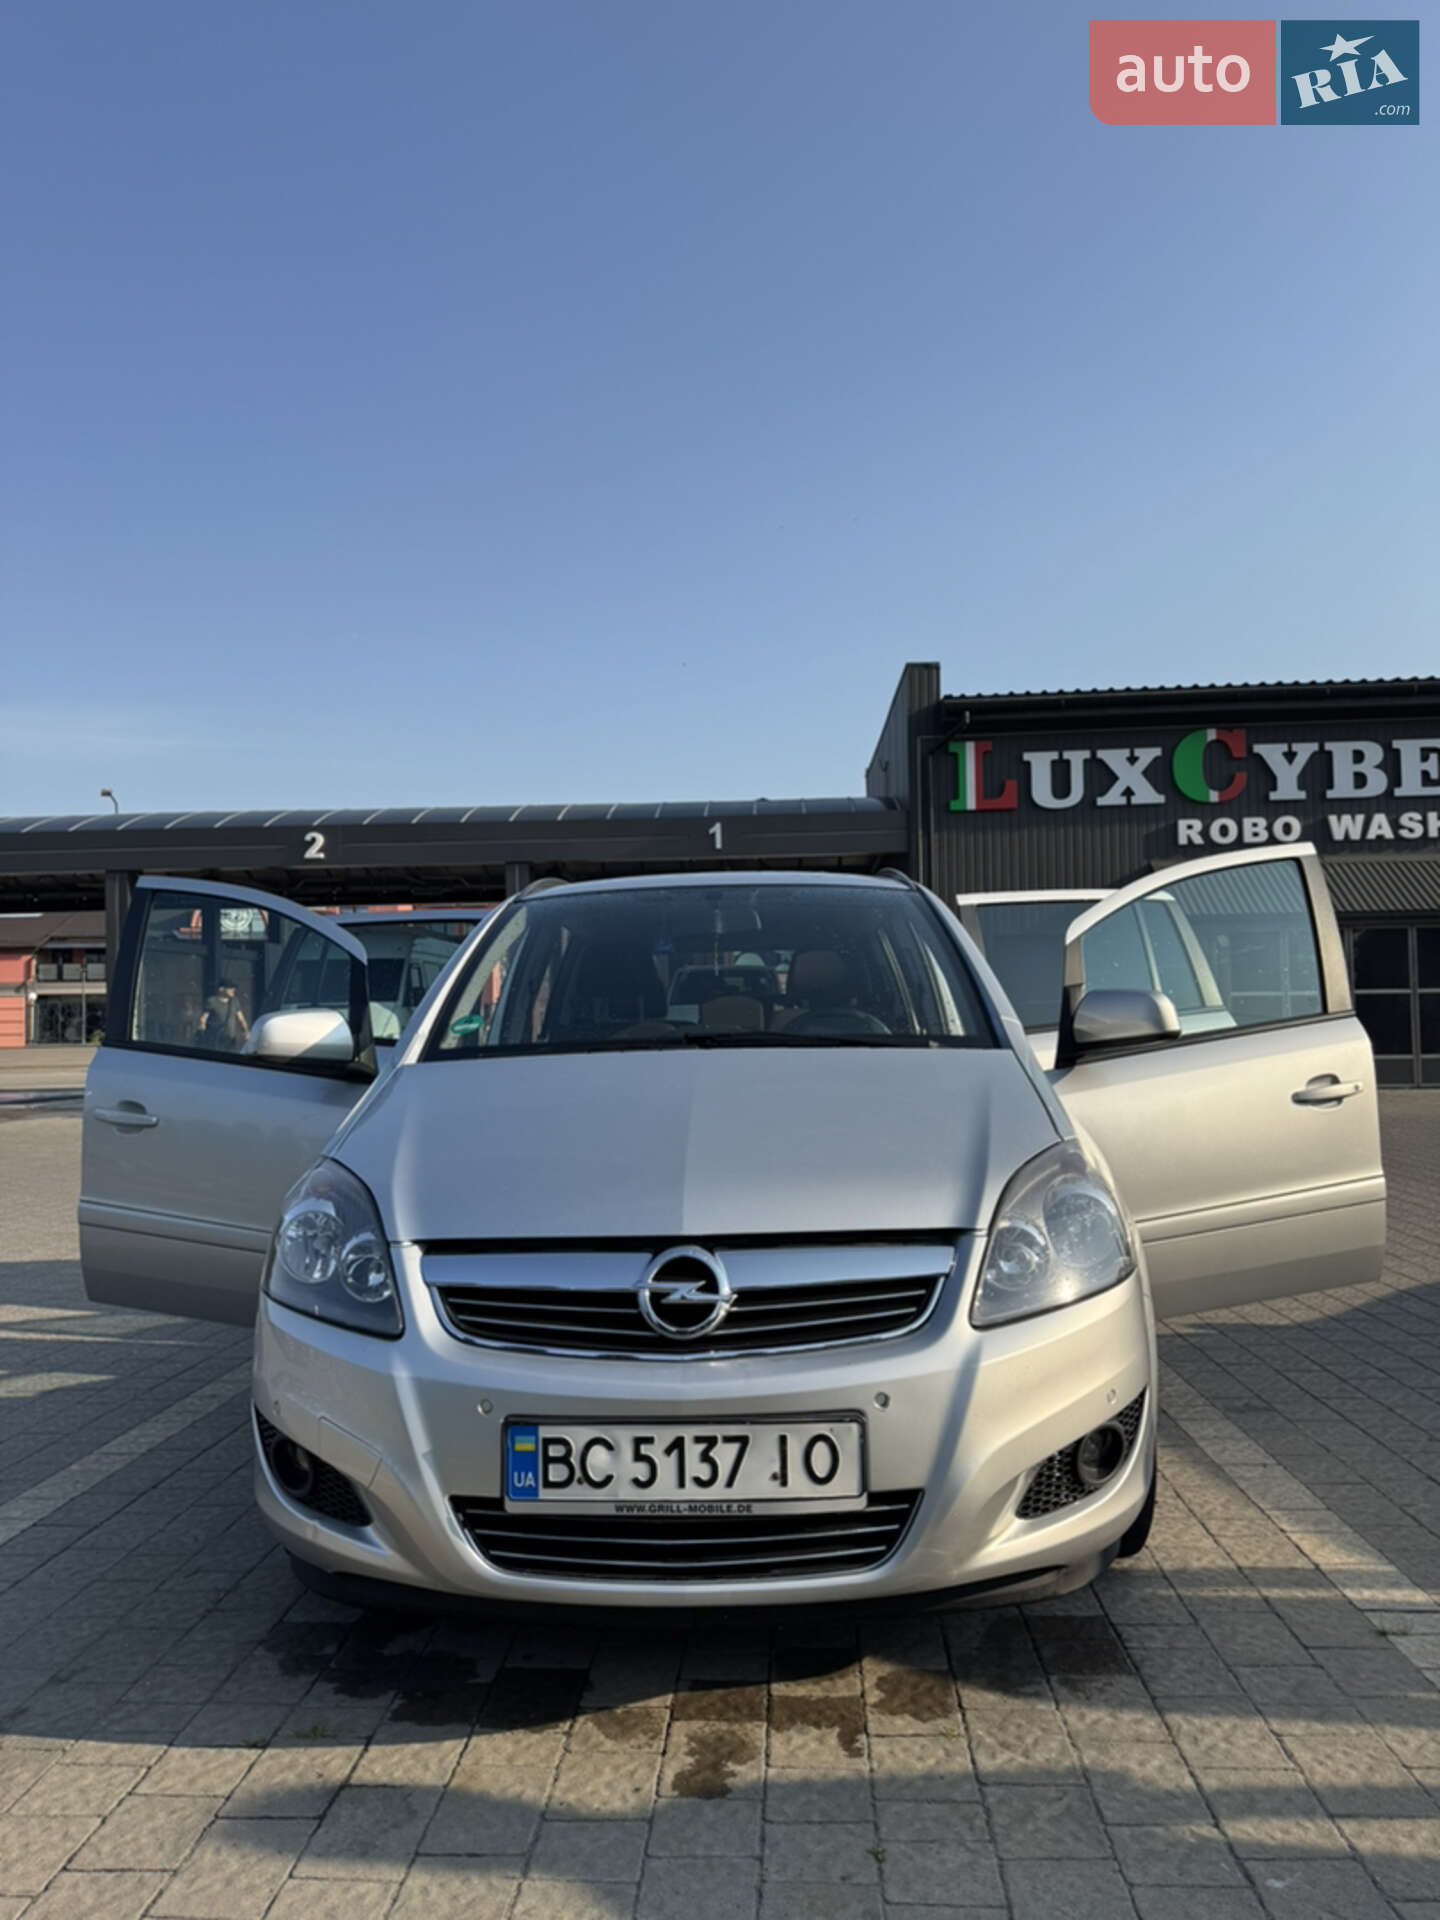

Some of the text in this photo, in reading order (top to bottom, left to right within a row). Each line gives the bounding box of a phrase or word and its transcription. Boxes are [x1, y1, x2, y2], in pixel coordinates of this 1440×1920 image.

[709, 821, 722, 849] 1
[1177, 815, 1302, 845] ROBO
[304, 831, 325, 859] 2
[542, 1436, 616, 1490] BC
[631, 1435, 750, 1490] 5137
[513, 1471, 536, 1488] UA
[613, 1503, 753, 1514] WWW.GRILL-MOBILE.DE
